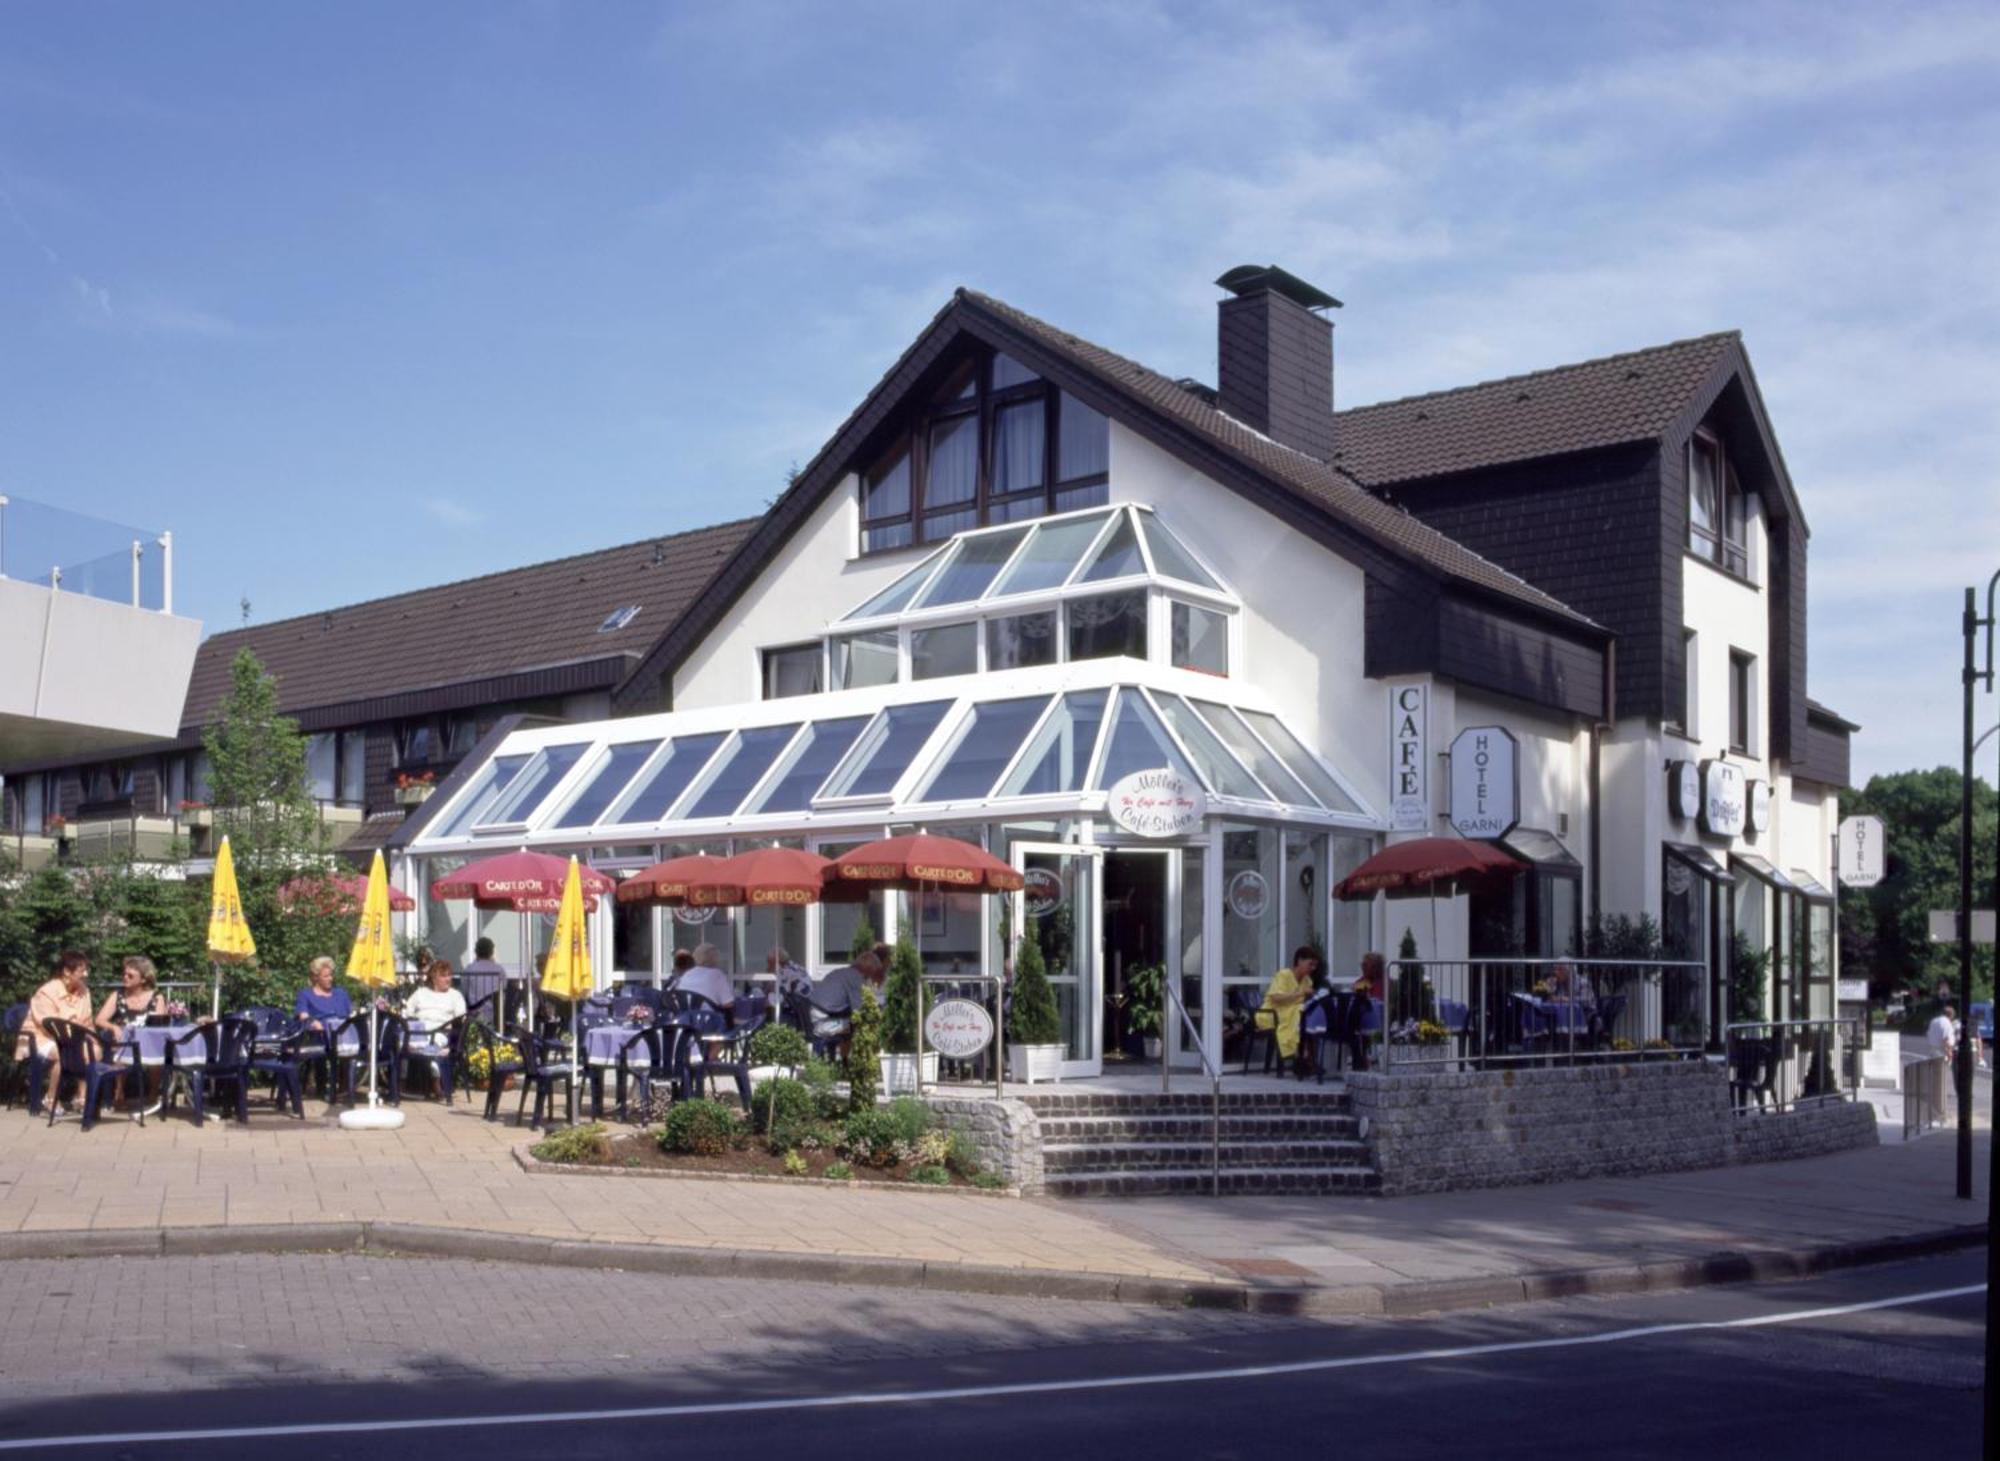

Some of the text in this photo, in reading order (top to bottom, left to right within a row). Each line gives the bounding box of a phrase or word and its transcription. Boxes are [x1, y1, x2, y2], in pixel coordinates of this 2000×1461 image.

[1399, 688, 1420, 795] CAFÉ
[1475, 735, 1489, 815] HOTEL
[1459, 820, 1502, 831] GARNI
[1856, 820, 1866, 871] HOTEL
[1845, 873, 1878, 882] GARNI
